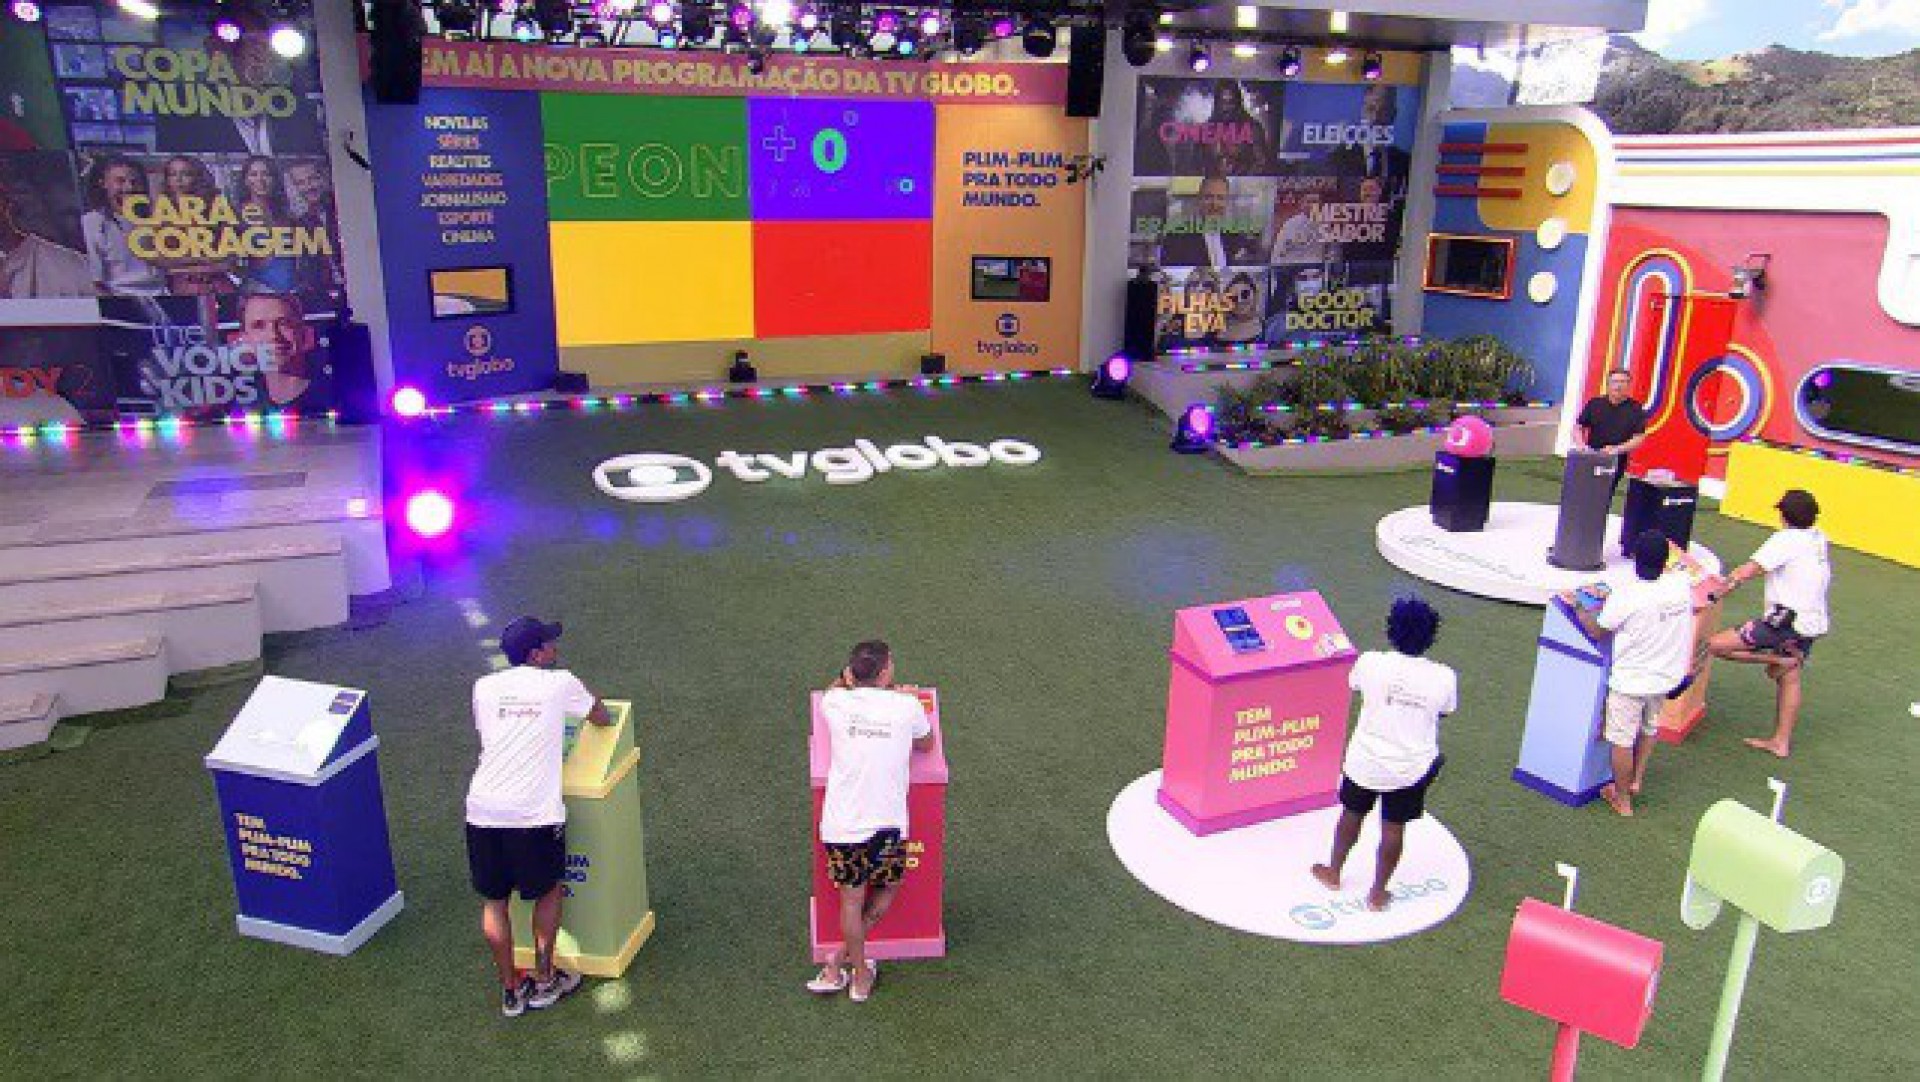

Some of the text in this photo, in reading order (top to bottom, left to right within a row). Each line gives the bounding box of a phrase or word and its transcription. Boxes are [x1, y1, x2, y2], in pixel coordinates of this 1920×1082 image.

[115, 47, 239, 84] COPA
[422, 45, 1020, 97] EM AÍ A NOVA PROGRAMAÇÃO DA TV GLOBO.
[123, 80, 297, 118] MUNDO
[424, 116, 489, 130] NOVELAS
[1160, 122, 1253, 144] CINEMA
[1303, 120, 1395, 149] ELEIÇÕES
[962, 151, 1064, 168] PLIM-PLIM
[421, 173, 504, 187] VARIEDADES
[962, 173, 1058, 187] PRA TODO
[121, 193, 238, 226] CARA
[420, 191, 508, 207] JORNALISMO
[962, 192, 1042, 207] MUNDO.
[437, 209, 495, 224] ESPORTE
[1308, 202, 1388, 222] MESTRE
[128, 225, 333, 259] CORAGEM
[441, 229, 495, 244] CINEMA
[1316, 223, 1386, 243] SABOR
[1157, 291, 1236, 315] FILHAS
[1298, 290, 1366, 311] GOOD
[1184, 311, 1227, 334] EVA
[1286, 308, 1375, 330] DOCTOR
[152, 343, 279, 377] VOICE
[977, 340, 1039, 359] tvglobo
[446, 358, 514, 379] tvglobo
[159, 375, 258, 407] KIDS
[716, 435, 1042, 486] tvglobo
[1235, 705, 1272, 726] TEM
[1232, 714, 1320, 746] PLIM-PLIM
[1231, 734, 1315, 763] PRA TODO
[1229, 756, 1299, 783] MUNDO.
